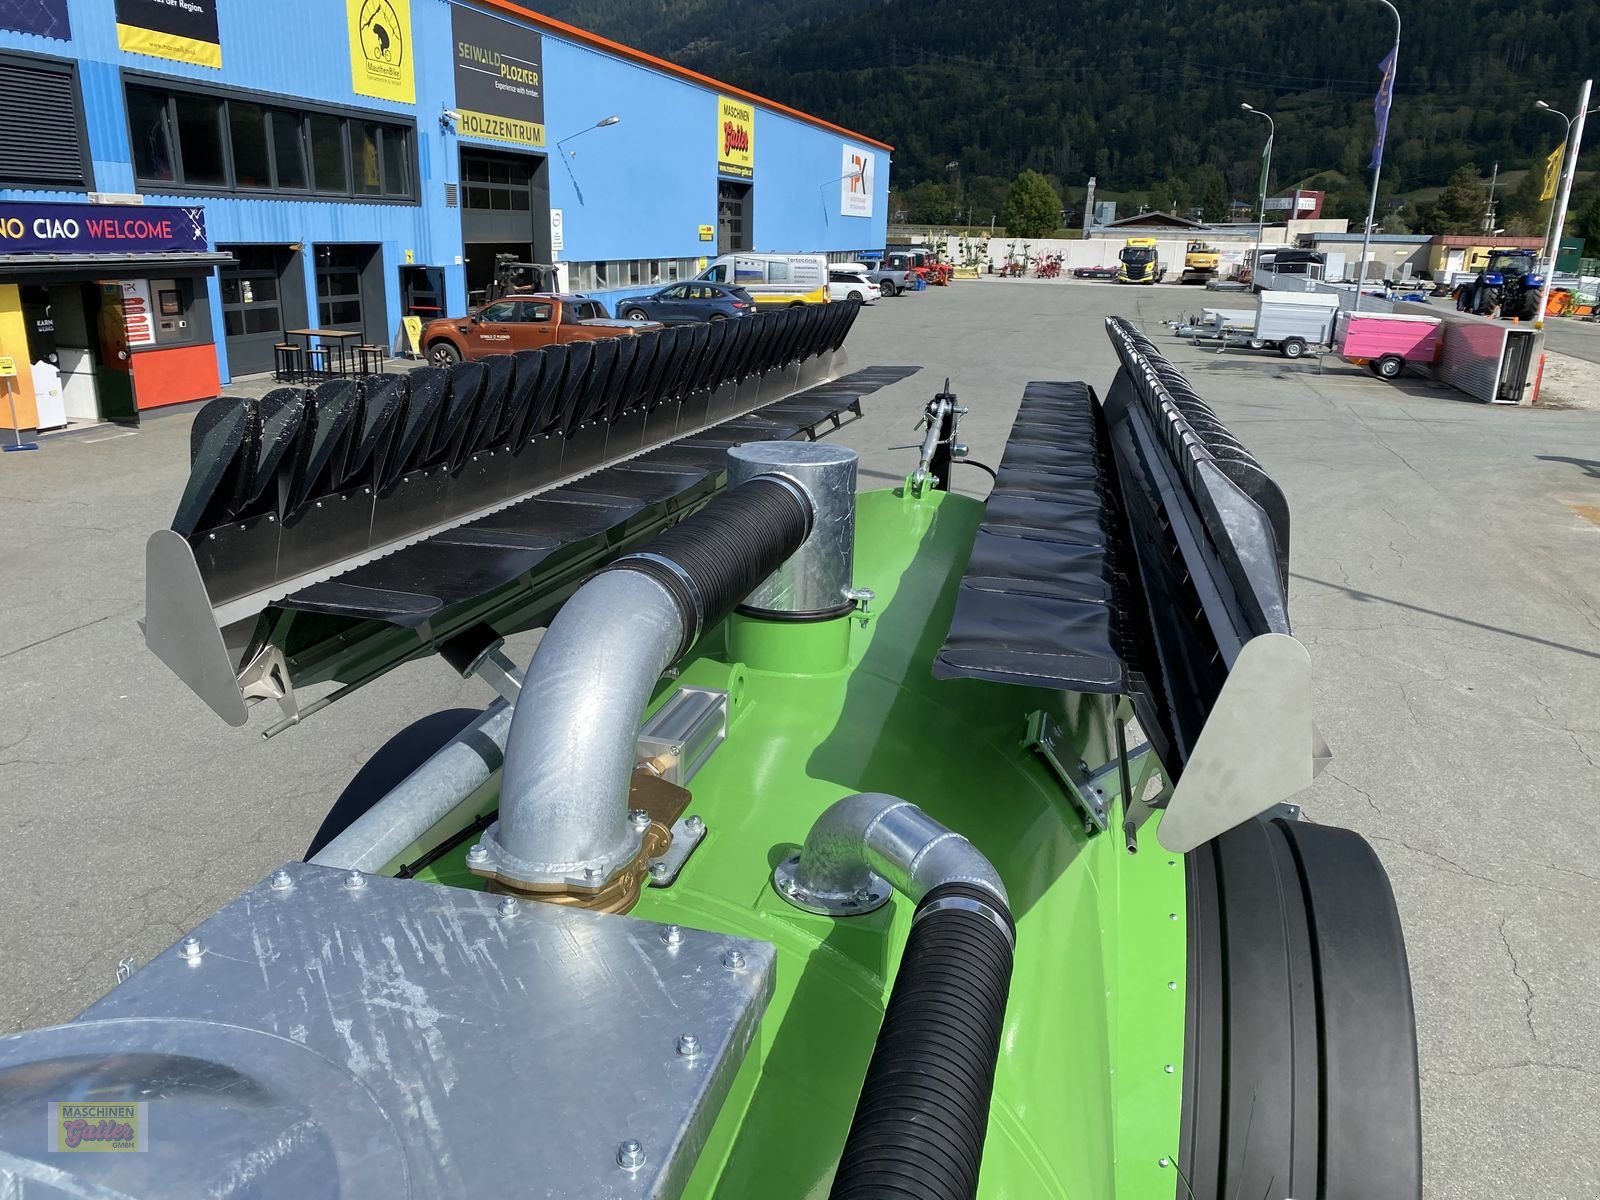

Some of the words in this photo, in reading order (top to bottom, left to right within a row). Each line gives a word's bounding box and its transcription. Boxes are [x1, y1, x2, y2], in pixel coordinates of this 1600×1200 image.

[458, 42, 500, 67] SEIWALD
[494, 80, 517, 93] Experience
[723, 103, 750, 122] MASCHINEN
[462, 114, 542, 143] HOLZZENTRUM
[33, 218, 80, 239] CIAO
[85, 219, 173, 239] WELCOME
